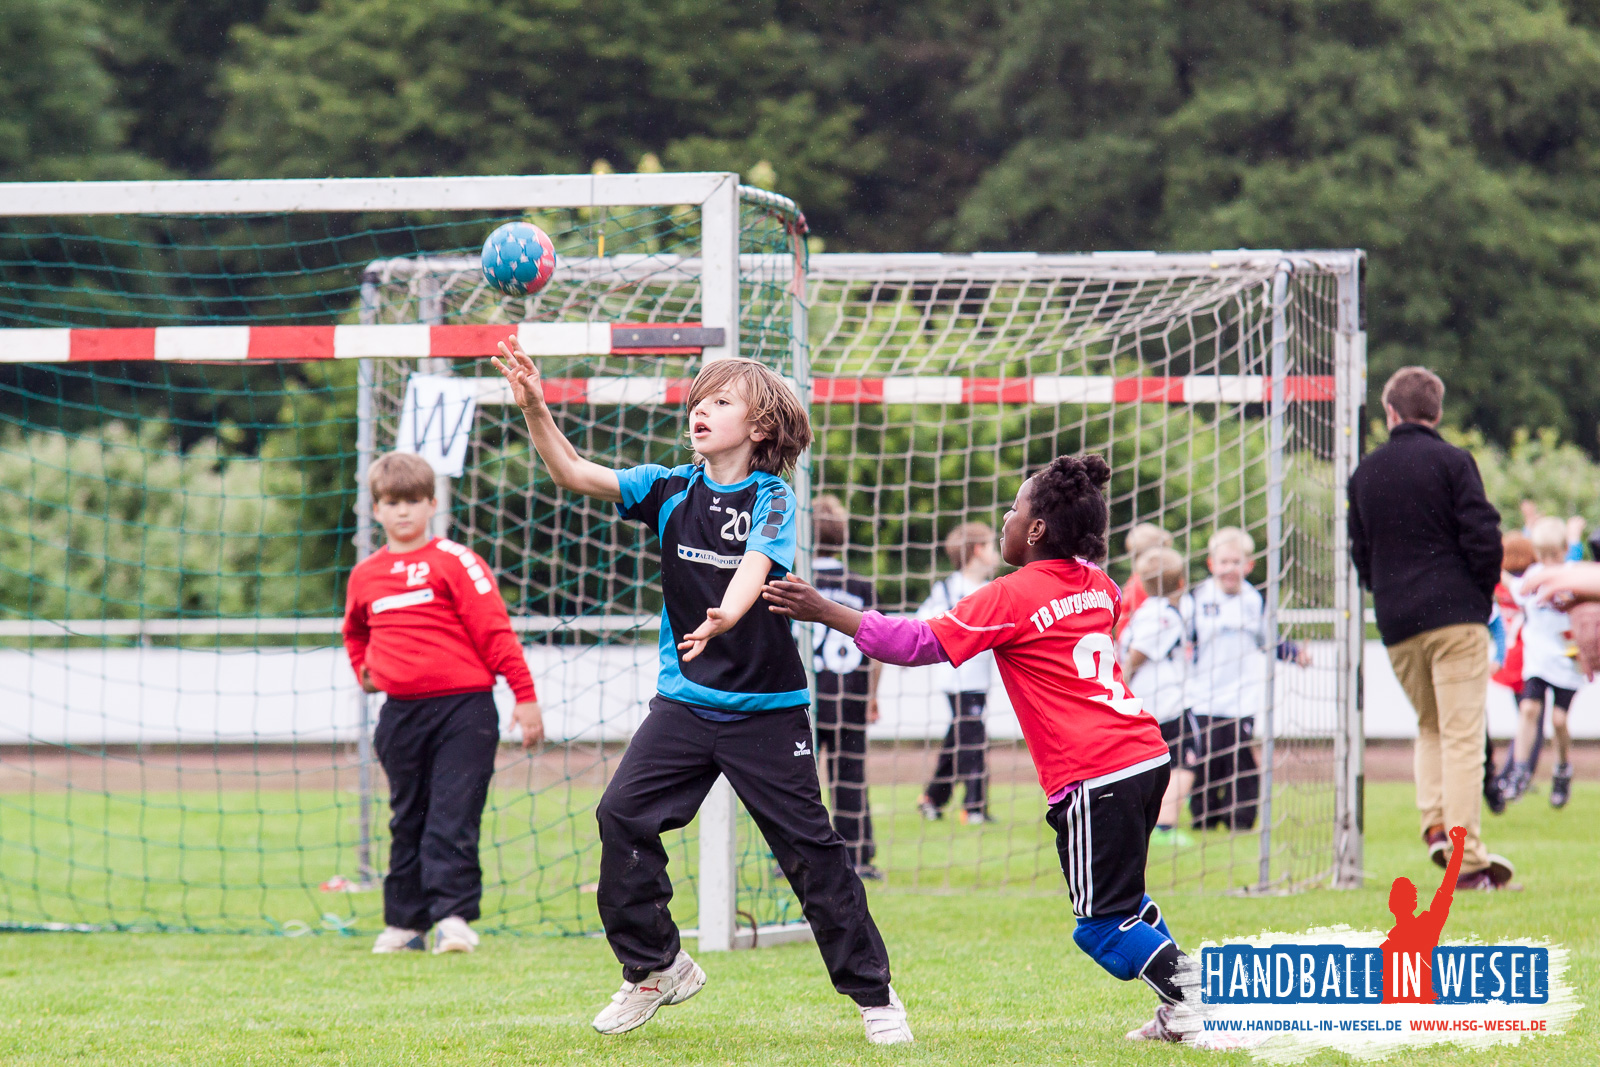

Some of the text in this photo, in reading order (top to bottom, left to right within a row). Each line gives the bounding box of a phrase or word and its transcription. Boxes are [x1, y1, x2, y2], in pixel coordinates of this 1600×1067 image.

[413, 387, 471, 456] W
[720, 507, 752, 542] 20
[406, 561, 430, 587] 12
[1029, 606, 1054, 634] TB
